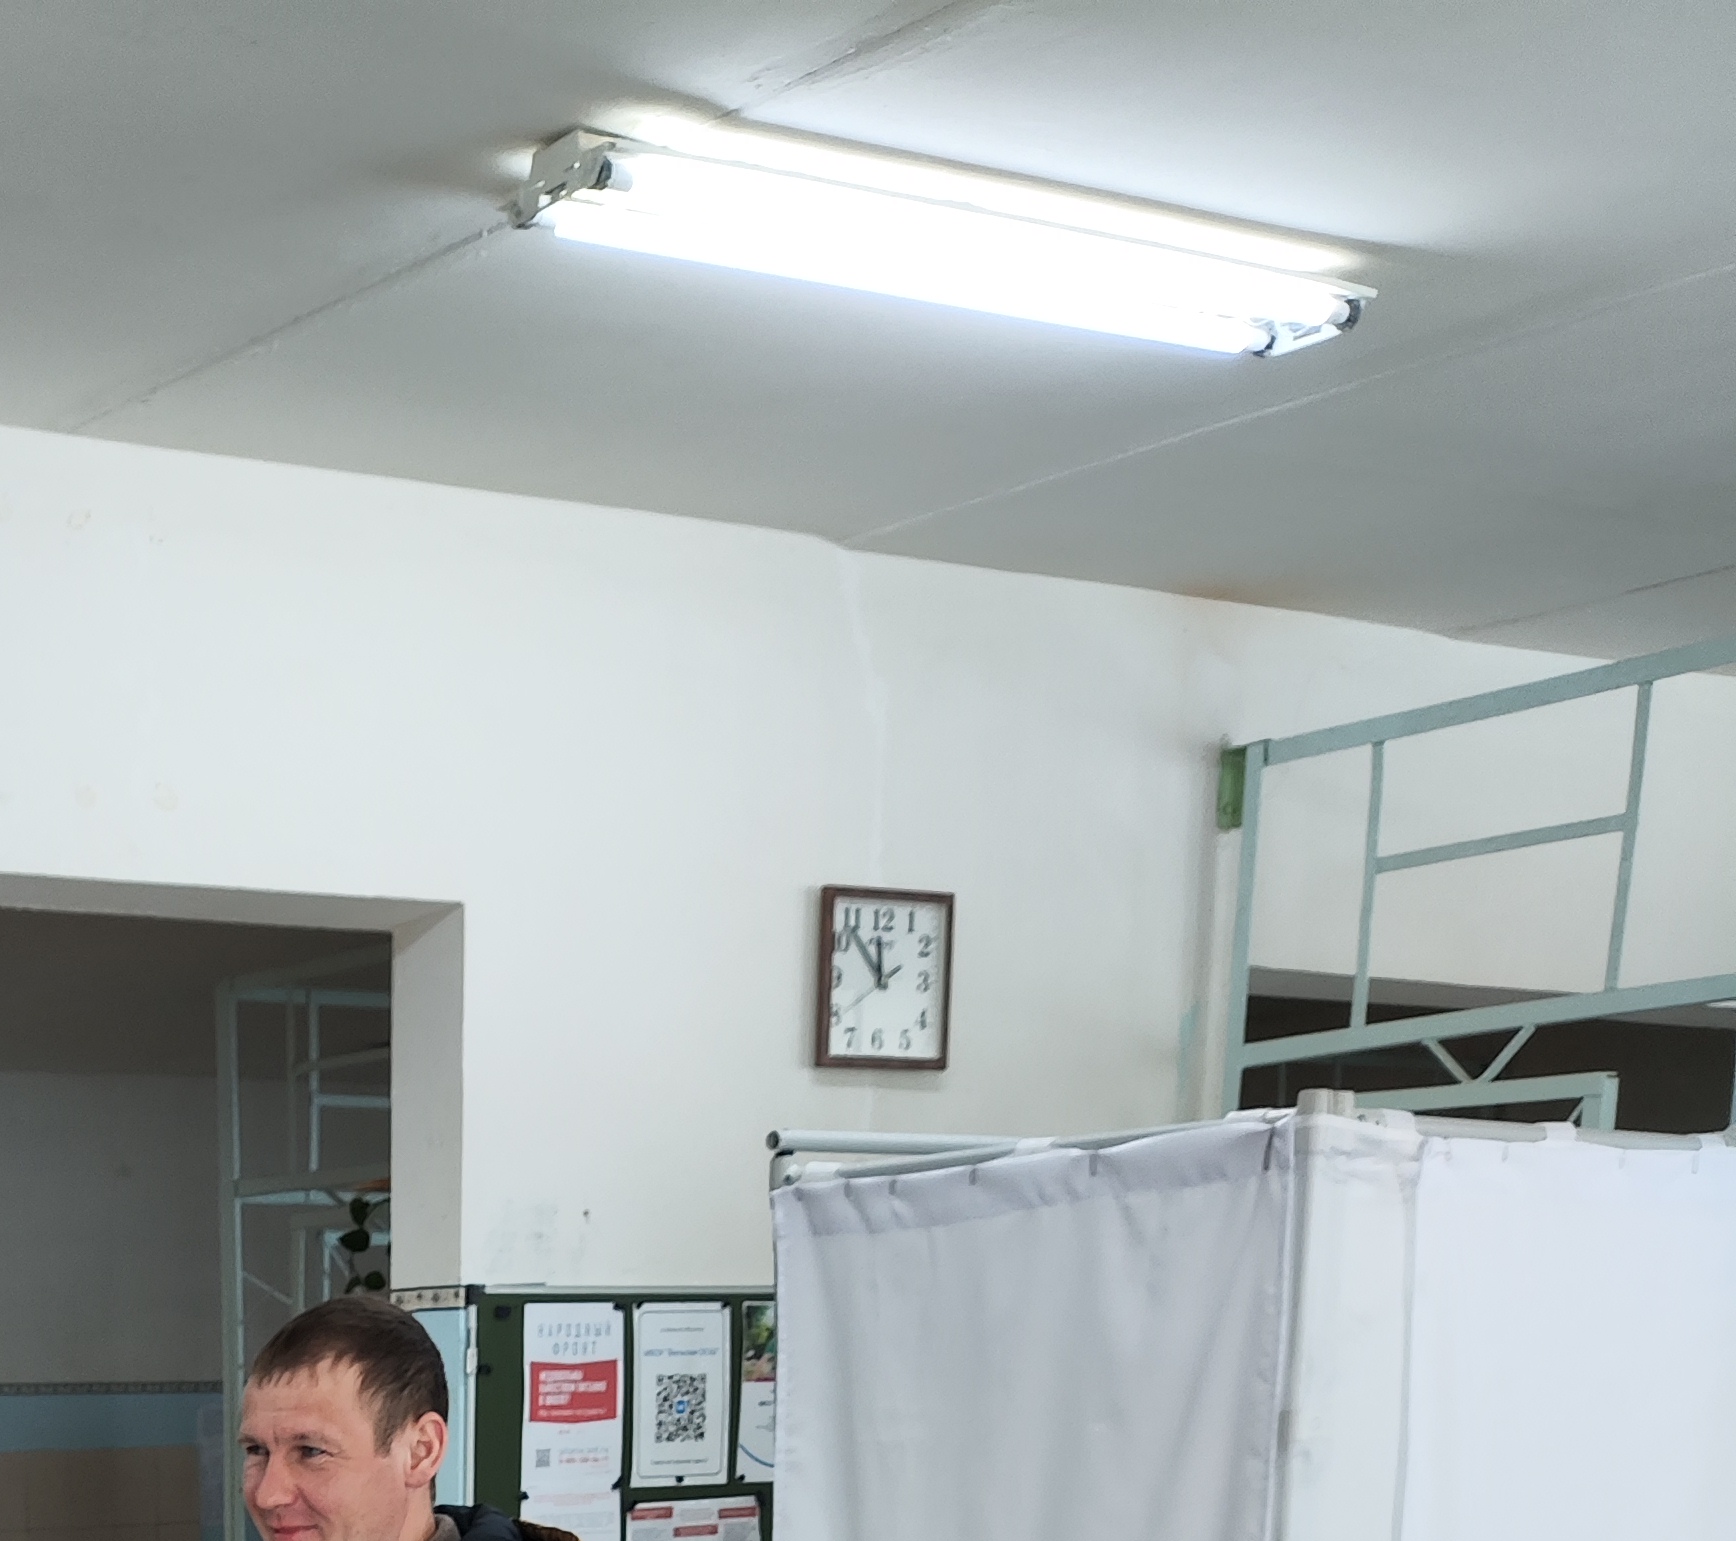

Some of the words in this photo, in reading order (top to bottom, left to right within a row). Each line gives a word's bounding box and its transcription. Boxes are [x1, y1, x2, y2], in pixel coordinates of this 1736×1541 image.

[873, 907, 895, 932] 12
[907, 909, 916, 933] 1
[918, 933, 932, 958] 2
[917, 969, 931, 993] 3
[844, 1026, 857, 1049] 7
[871, 1027, 884, 1050] 6
[899, 1028, 911, 1051] 5
